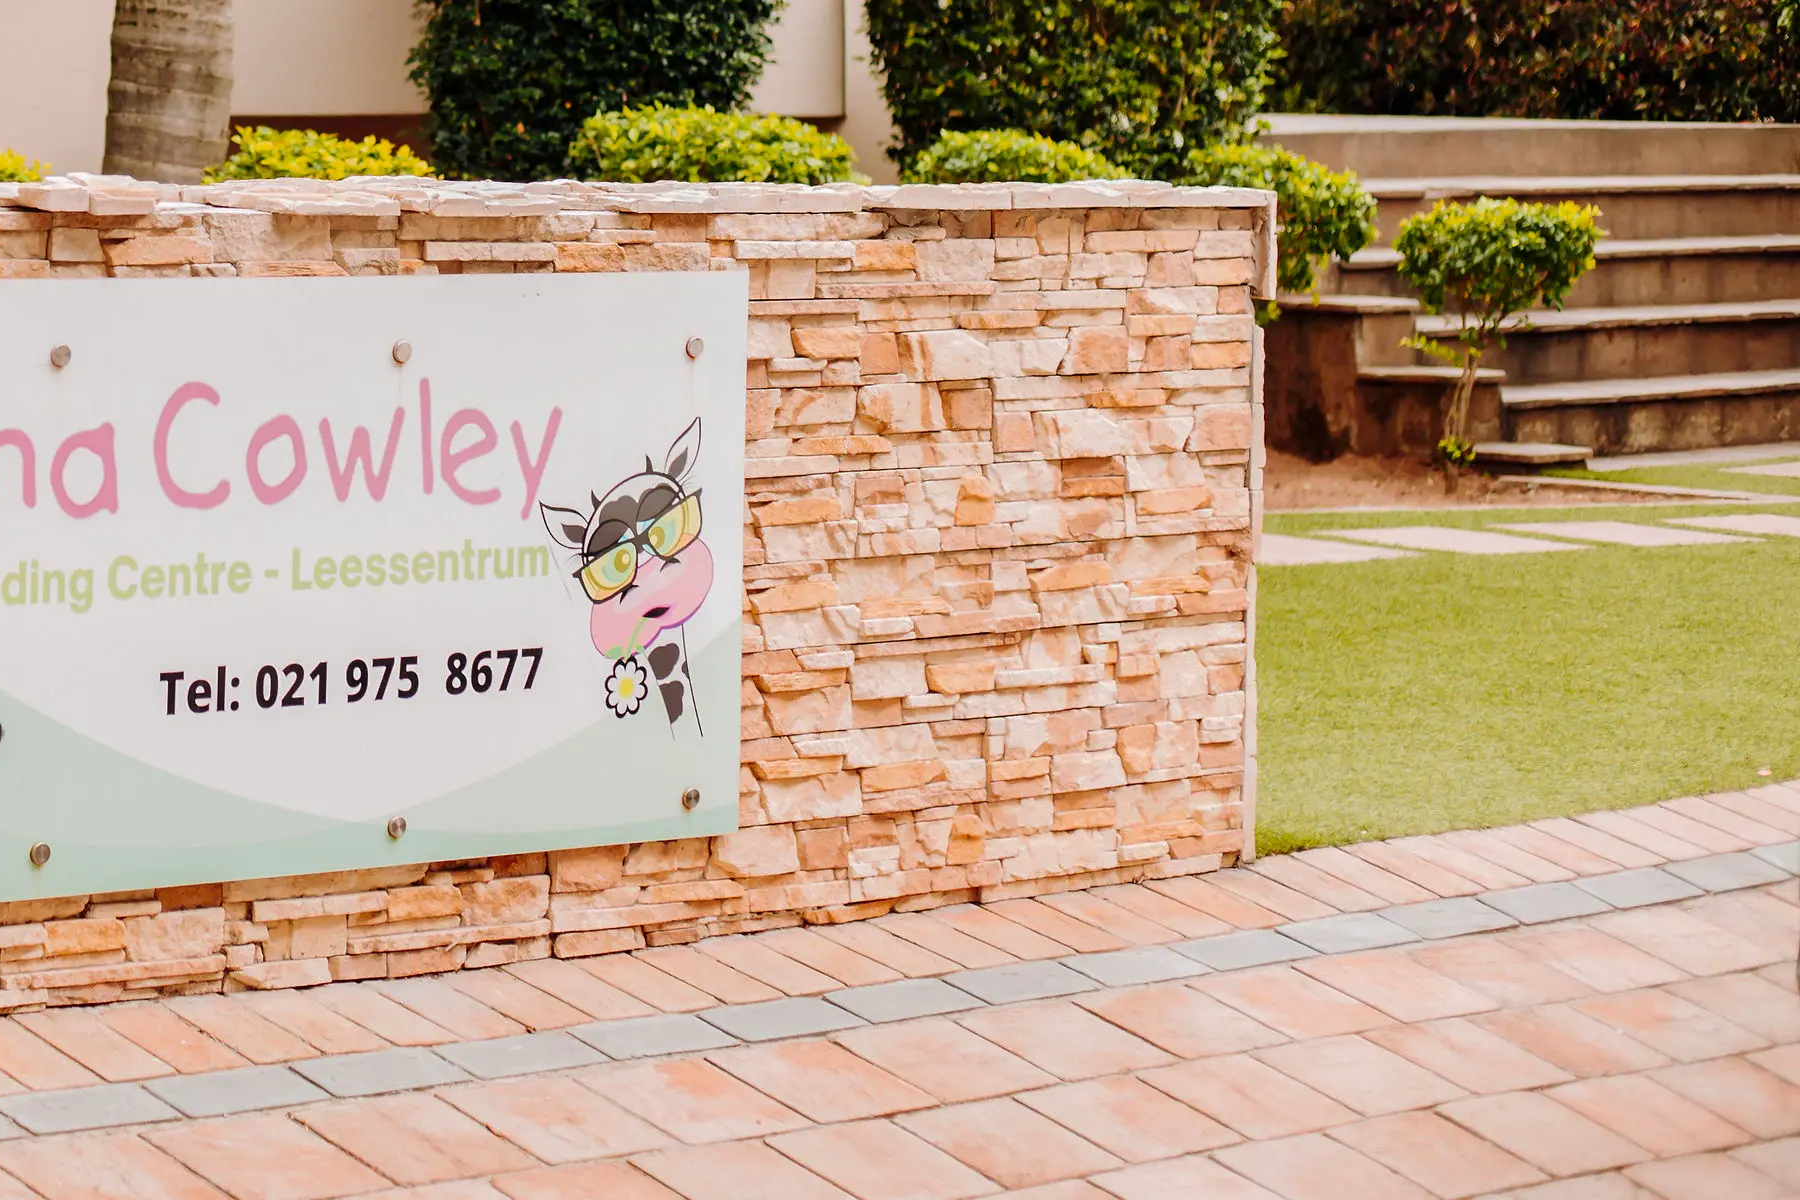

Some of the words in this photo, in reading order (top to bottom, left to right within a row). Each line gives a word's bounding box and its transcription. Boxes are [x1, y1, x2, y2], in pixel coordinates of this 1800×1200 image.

[153, 377, 562, 520] Cowley
[108, 551, 251, 600] Centre
[265, 569, 279, 578] -
[291, 539, 549, 590] Leessentrum
[159, 665, 240, 716] Tel:
[255, 661, 328, 709] 021
[345, 655, 420, 703] 975
[445, 647, 544, 696] 8677
